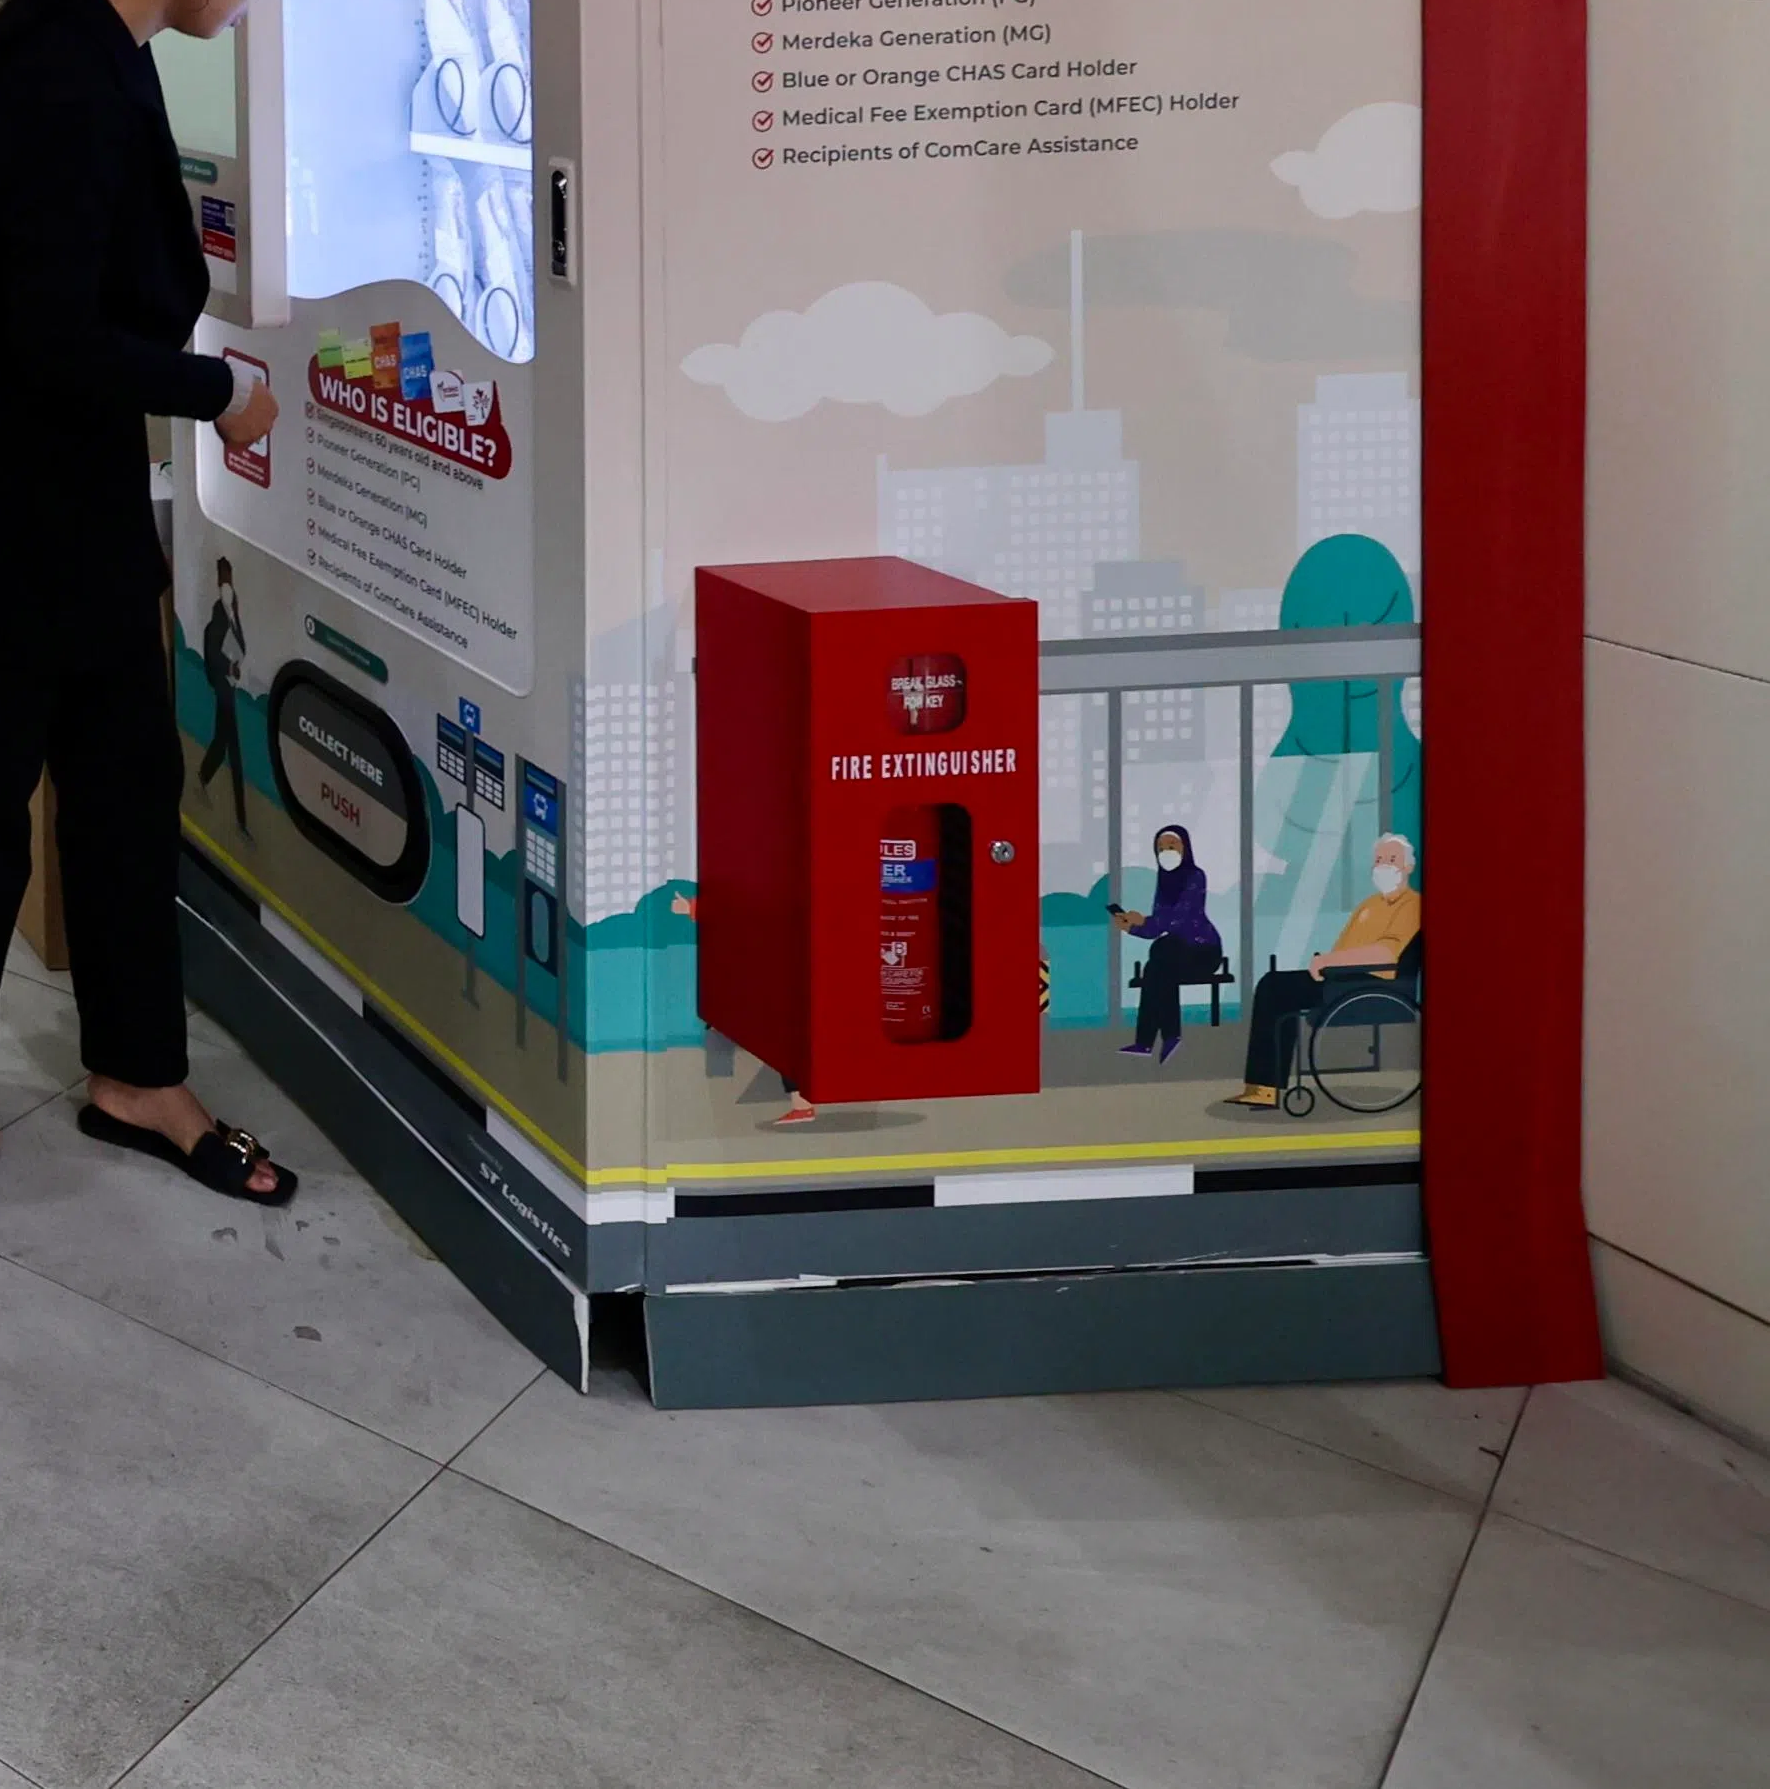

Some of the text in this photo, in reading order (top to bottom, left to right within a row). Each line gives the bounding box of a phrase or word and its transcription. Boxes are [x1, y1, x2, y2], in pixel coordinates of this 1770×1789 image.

[782, 23, 1051, 51] Merdeka Generation (MG)
[782, 58, 1137, 90] Blue or Orange CHAS Card Holder
[782, 92, 1239, 127] Medical Fee Exemption Card (MFEC) Holder
[782, 134, 1139, 168] Recipients of ComCare Assistance
[373, 354, 397, 369] CHAS
[402, 364, 428, 380] CHAS
[318, 373, 497, 467] WHO IS ELIGIBLE?
[316, 406, 484, 490] Singaporeans 60 years old and above
[317, 433, 421, 492] Pioneer Generation (PG)
[317, 463, 428, 529] Merdeka Generation (MG)
[318, 494, 467, 580] Blue or Orange CHAS Card Holder
[318, 526, 517, 640] Medical Fee Exemption Card (MFEC) Holder
[318, 556, 469, 649] Recipients of ComCare Assistance
[891, 674, 956, 691] BREAK GLASS
[903, 694, 944, 710] FOR KEY
[298, 715, 384, 787] COLLECT HERE
[831, 748, 1017, 781] FIRE EXTINGUISHER
[320, 782, 361, 827] PUSH
[880, 844, 915, 857] LES
[479, 1162, 572, 1258] ST Logistics
